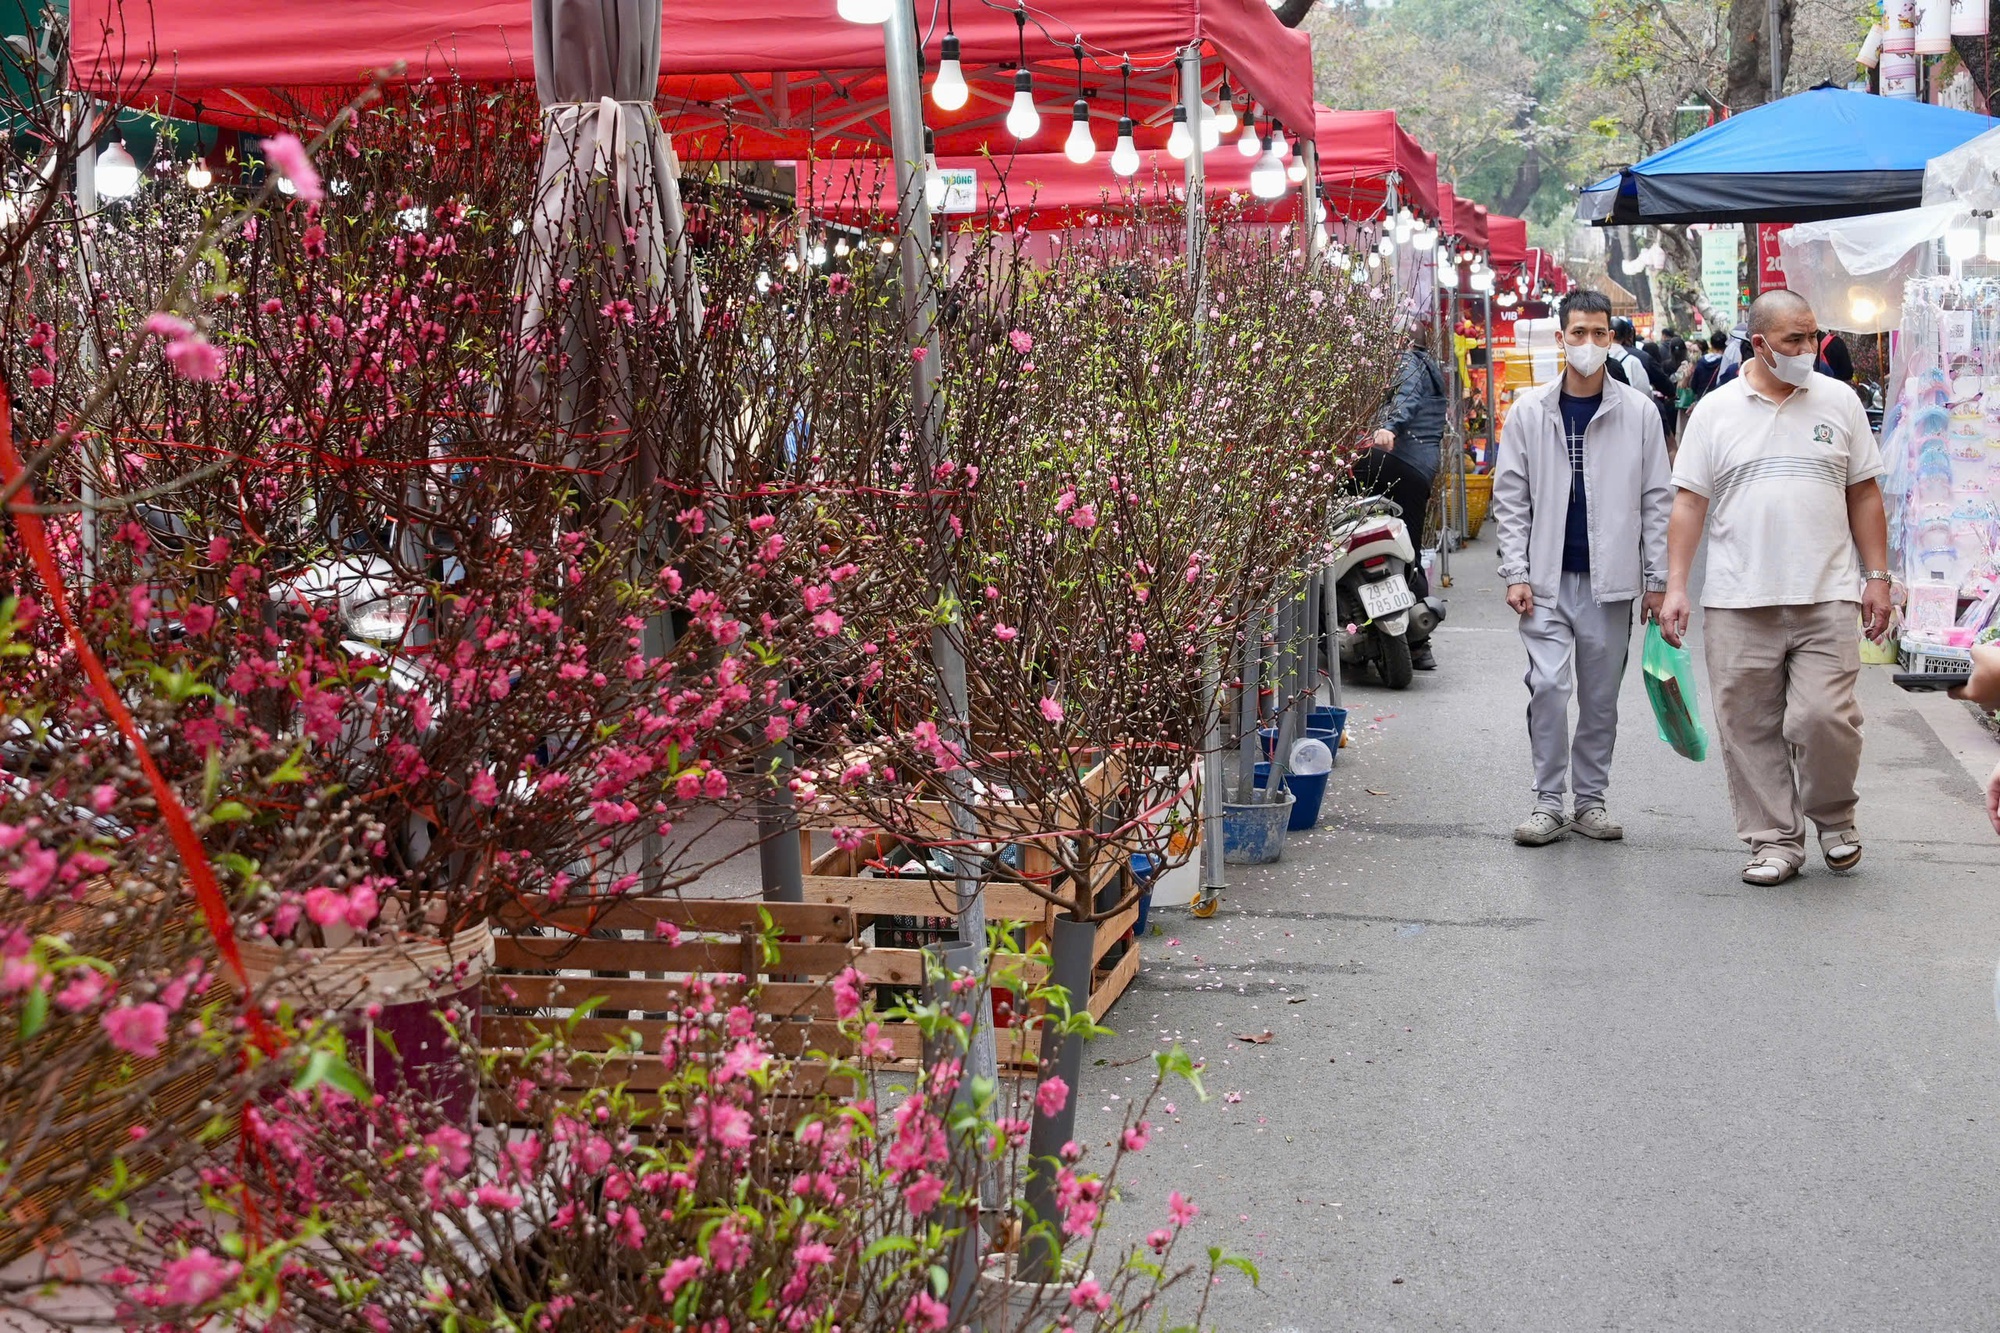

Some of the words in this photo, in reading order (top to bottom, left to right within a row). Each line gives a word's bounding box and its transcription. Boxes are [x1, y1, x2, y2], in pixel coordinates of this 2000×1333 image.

[1501, 311, 1518, 321] VIB
[1367, 579, 1400, 600] 29-B1
[1368, 592, 1409, 615] 785.00
